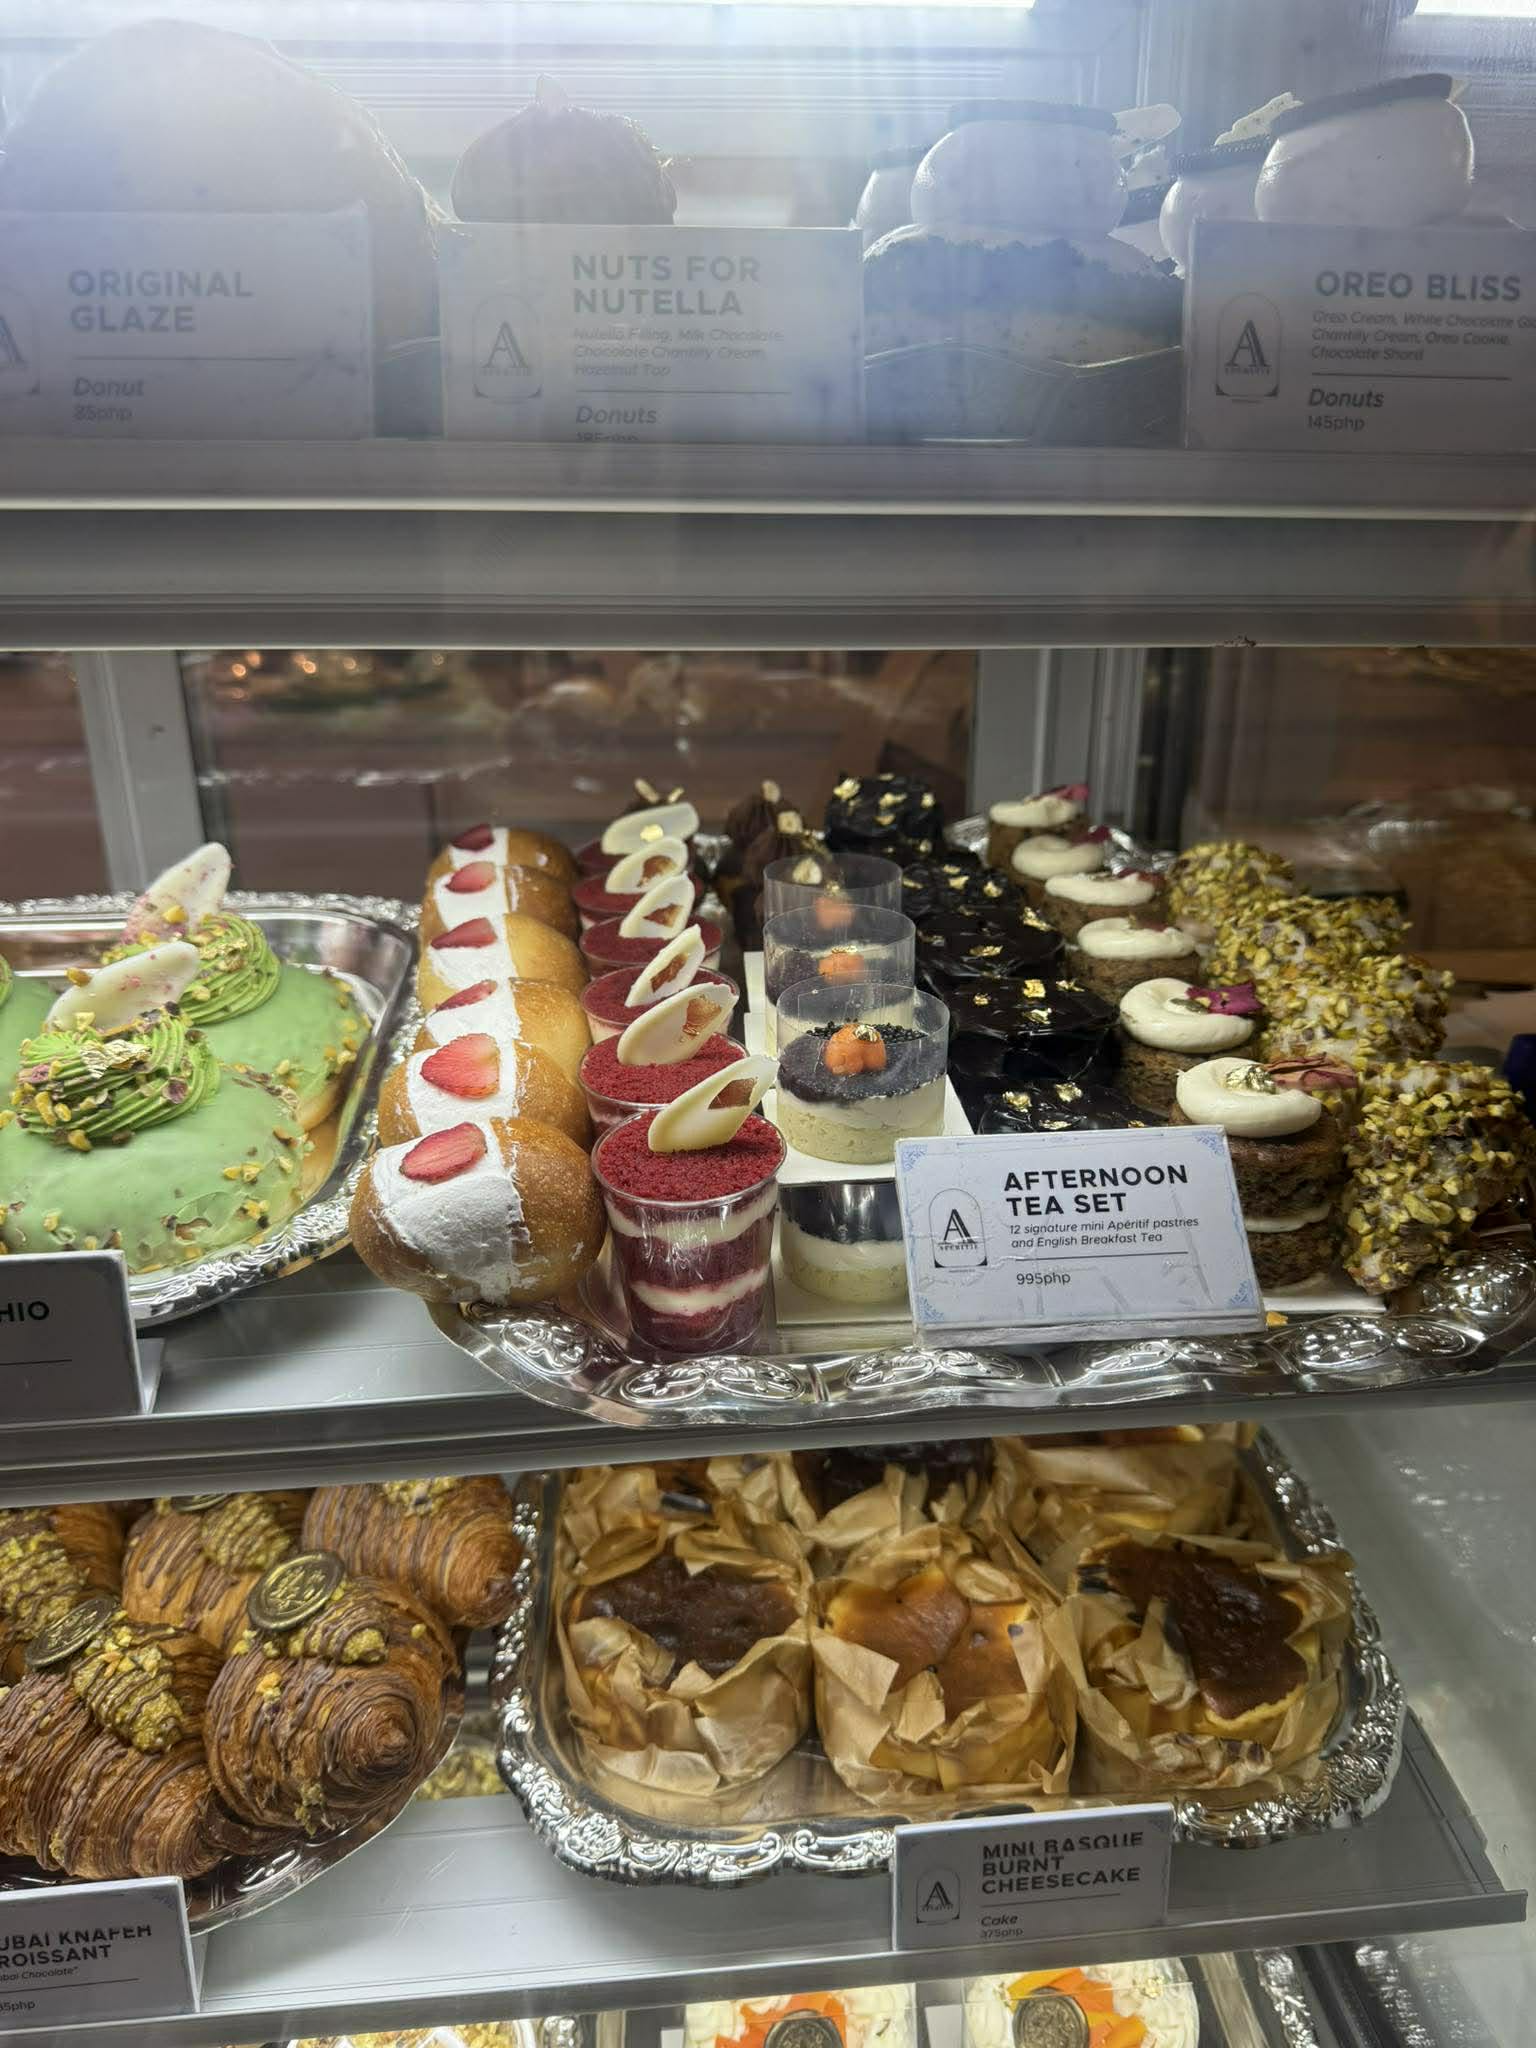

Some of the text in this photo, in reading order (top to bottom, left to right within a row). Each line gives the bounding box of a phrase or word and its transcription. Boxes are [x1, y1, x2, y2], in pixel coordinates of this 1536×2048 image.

[572, 255, 760, 282] NUTS FOR
[69, 270, 254, 297] ORIGINAL
[1315, 270, 1521, 301] OREO BLISS
[574, 288, 743, 315] NUTELLA
[70, 306, 195, 333] GLAZE
[1313, 311, 1347, 323] Oreo
[1404, 313, 1442, 326] White
[1312, 329, 1368, 344] Chantilly
[1424, 332, 1459, 344] Oreo
[575, 346, 649, 359] Chocolate
[1312, 346, 1378, 360] Chocolate
[73, 377, 144, 397] Donut
[1308, 388, 1384, 408] Donuts
[576, 405, 657, 424] Donuts
[1308, 415, 1366, 432] 145php
[1004, 1165, 1188, 1192] AFTERNOON
[1006, 1193, 1126, 1217] TEA SET
[1010, 1217, 1199, 1236] 12 signature mini Apéritif pastries
[1011, 1232, 1163, 1249] and English Breakfast Tea
[1016, 1272, 1071, 1286] 995php
[982, 1841, 1035, 1860] MINI
[982, 1856, 1065, 1877] BURNT
[982, 1867, 1140, 1894] CHEESECAKE
[981, 1913, 1018, 1927] Cake
